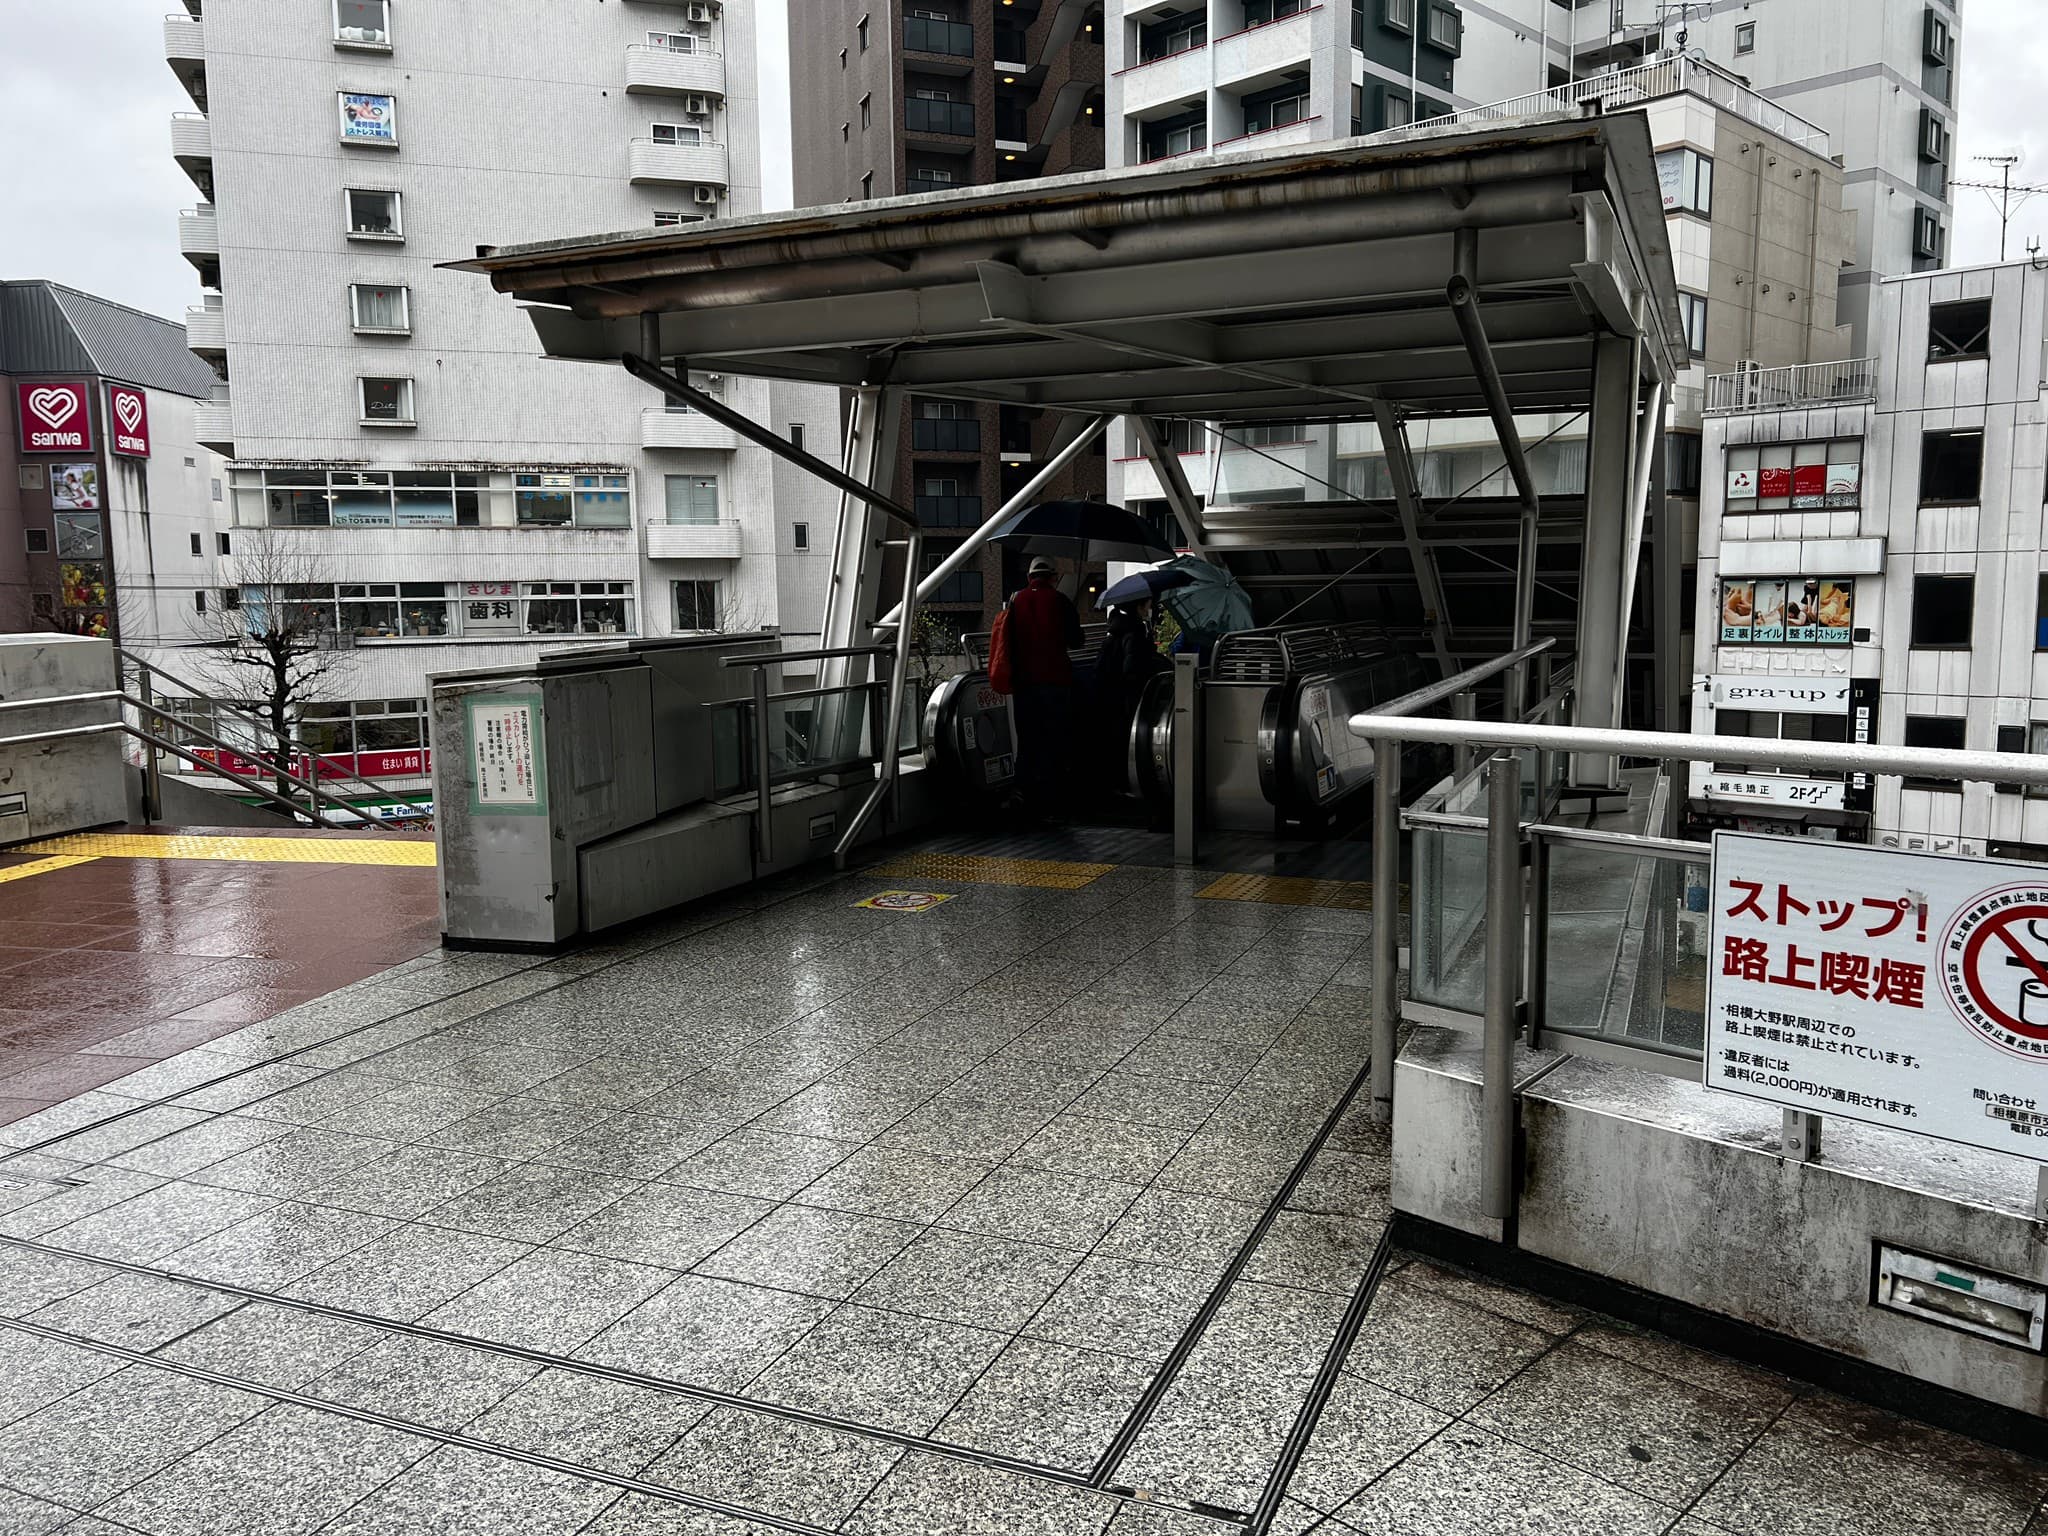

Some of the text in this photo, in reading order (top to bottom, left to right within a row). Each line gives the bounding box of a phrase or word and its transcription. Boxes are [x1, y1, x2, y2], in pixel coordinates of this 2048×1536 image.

[32, 432, 82, 446] sanwa
[118, 435, 145, 451] sanwa
[467, 584, 513, 595] さじま
[467, 601, 514, 619] 歯科
[1724, 628, 1849, 640] 足裏 オイル 整体 ストレッチ
[1729, 687, 1826, 702] gra-up
[382, 758, 403, 769] 住まい
[1720, 782, 1807, 800] 縮毛矯正 2F
[1726, 879, 1928, 943] ストップ!
[1722, 935, 1926, 1009] 路上喫煙
[1725, 1020, 1921, 1069] 路上喫煙は禁止されています。
[1973, 1088, 2037, 1110] 問い合わせ
[2010, 1123, 2032, 1135] 電話
